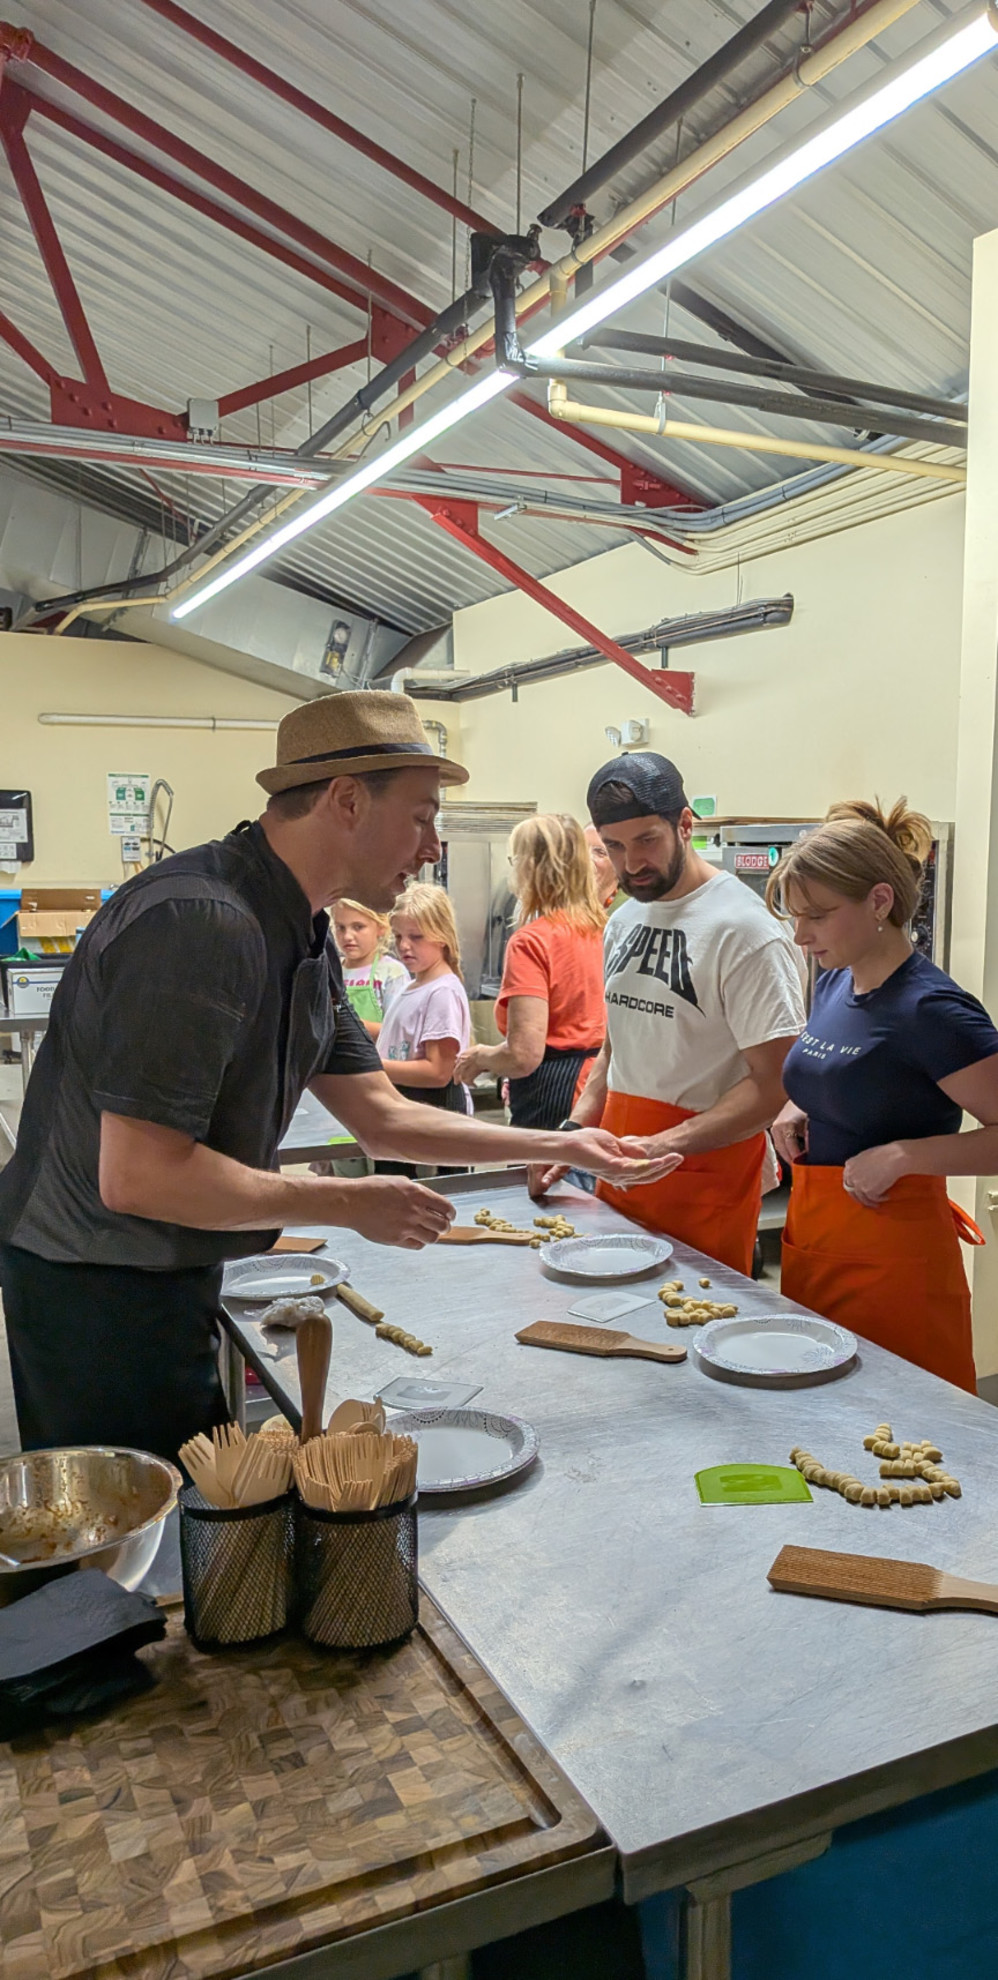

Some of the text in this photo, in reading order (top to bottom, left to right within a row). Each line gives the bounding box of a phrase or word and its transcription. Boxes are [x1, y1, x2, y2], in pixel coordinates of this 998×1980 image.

[606, 923, 706, 1018] SPEED
[605, 991, 675, 1018] HARDCORE
[802, 1047, 827, 1060] PARIS
[820, 1041, 835, 1051] LA
[840, 1045, 861, 1055] VIE
